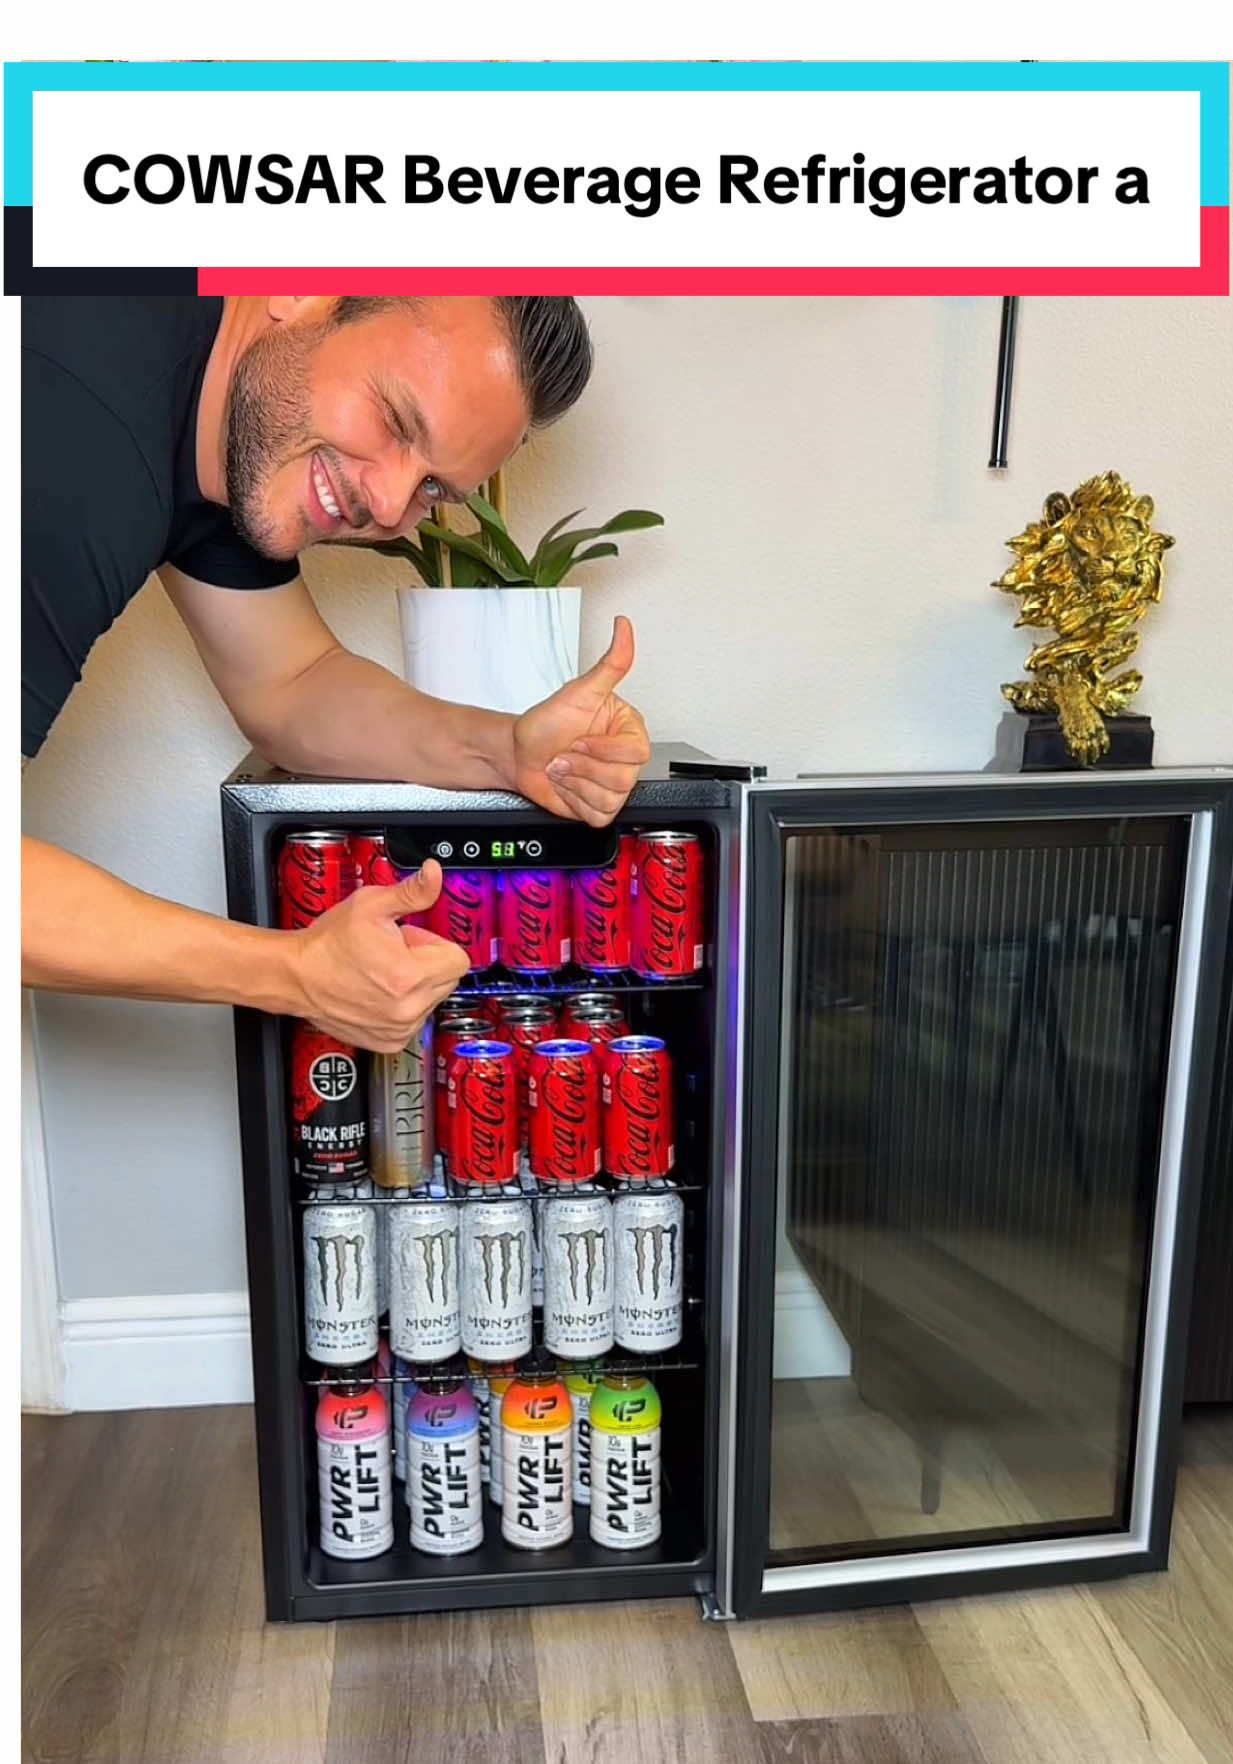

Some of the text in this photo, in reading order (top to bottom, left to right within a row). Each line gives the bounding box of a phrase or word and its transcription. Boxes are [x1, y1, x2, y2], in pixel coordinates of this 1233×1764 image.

[301, 1124, 338, 1142] BLACK
[340, 1121, 366, 1141] RIFLE
[354, 1445, 380, 1513] LIFT
[421, 1462, 445, 1539] PWR
[444, 1443, 470, 1509] LIFT
[517, 1455, 540, 1532] PWR
[543, 1435, 564, 1503] LIFT
[606, 1457, 629, 1533] PWR
[631, 1437, 653, 1505] LIFT
[330, 1464, 354, 1543] PWR
